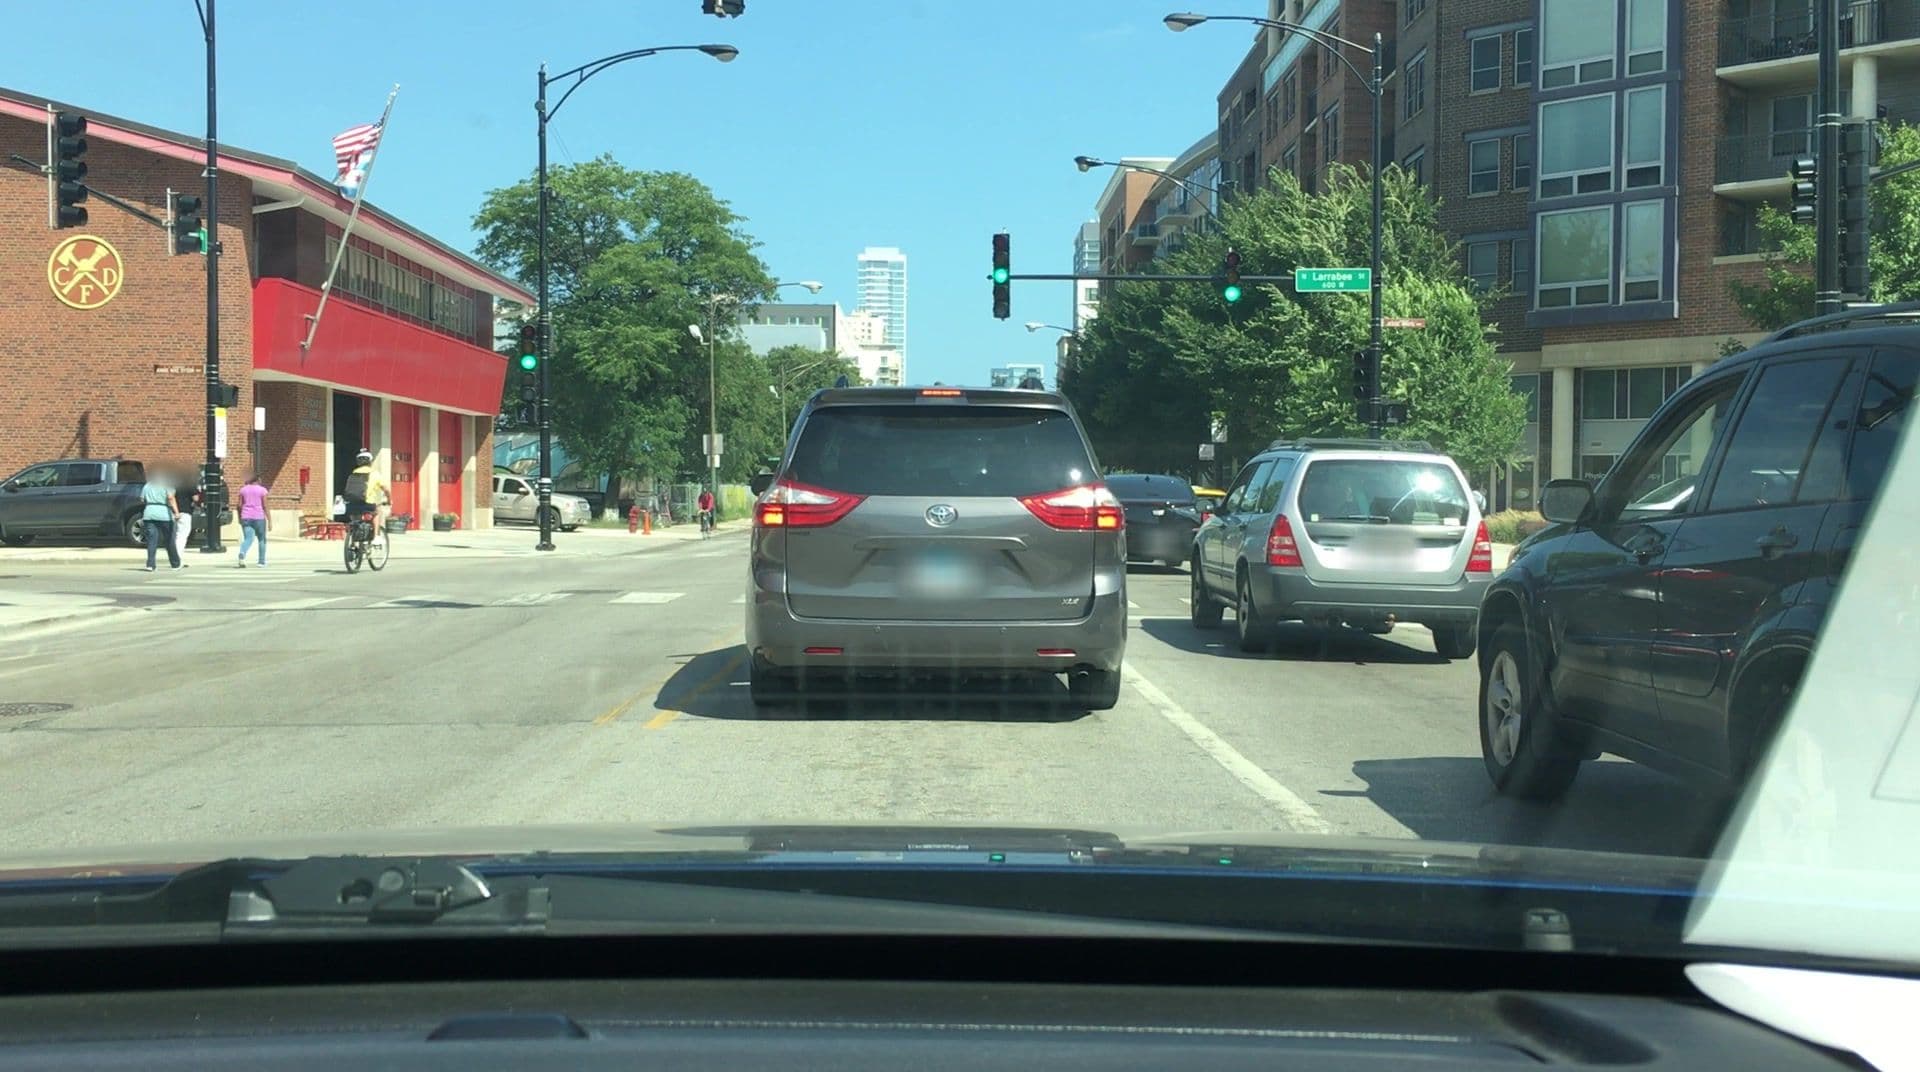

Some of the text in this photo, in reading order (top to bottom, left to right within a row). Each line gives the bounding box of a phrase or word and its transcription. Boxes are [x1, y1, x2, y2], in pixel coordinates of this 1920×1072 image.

[54, 267, 118, 304] C F D
[1312, 272, 1352, 281] Larrabee
